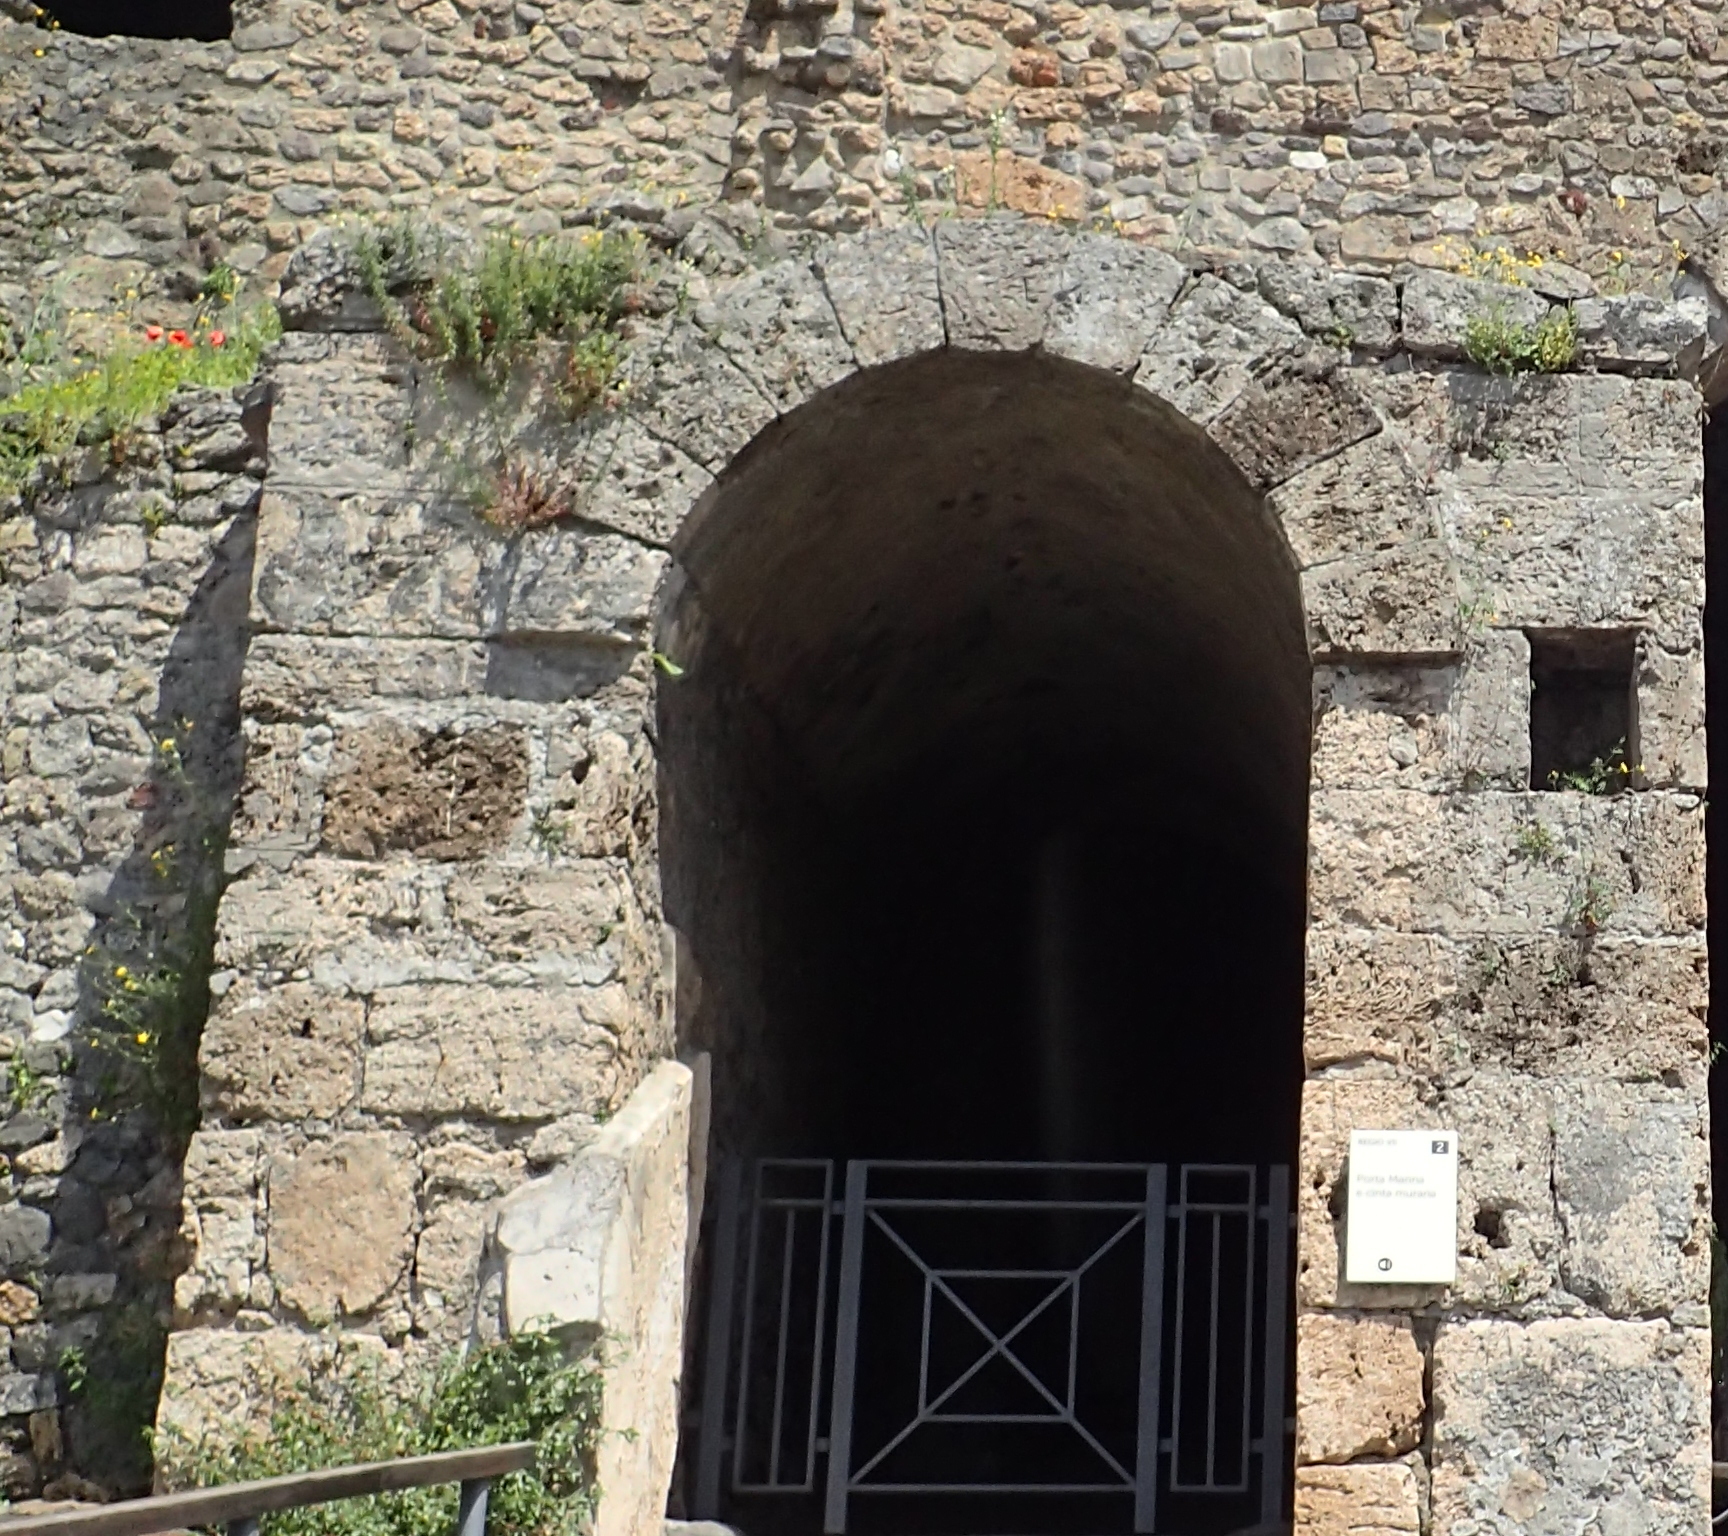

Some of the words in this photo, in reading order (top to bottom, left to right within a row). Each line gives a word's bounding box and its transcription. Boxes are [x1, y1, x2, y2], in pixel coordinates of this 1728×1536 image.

[1436, 1142, 1444, 1152] 2
[1356, 1174, 1385, 1183] Porta
[1388, 1174, 1424, 1183] Marina
[1366, 1189, 1392, 1198] cinta
[1395, 1190, 1436, 1198] muraria
